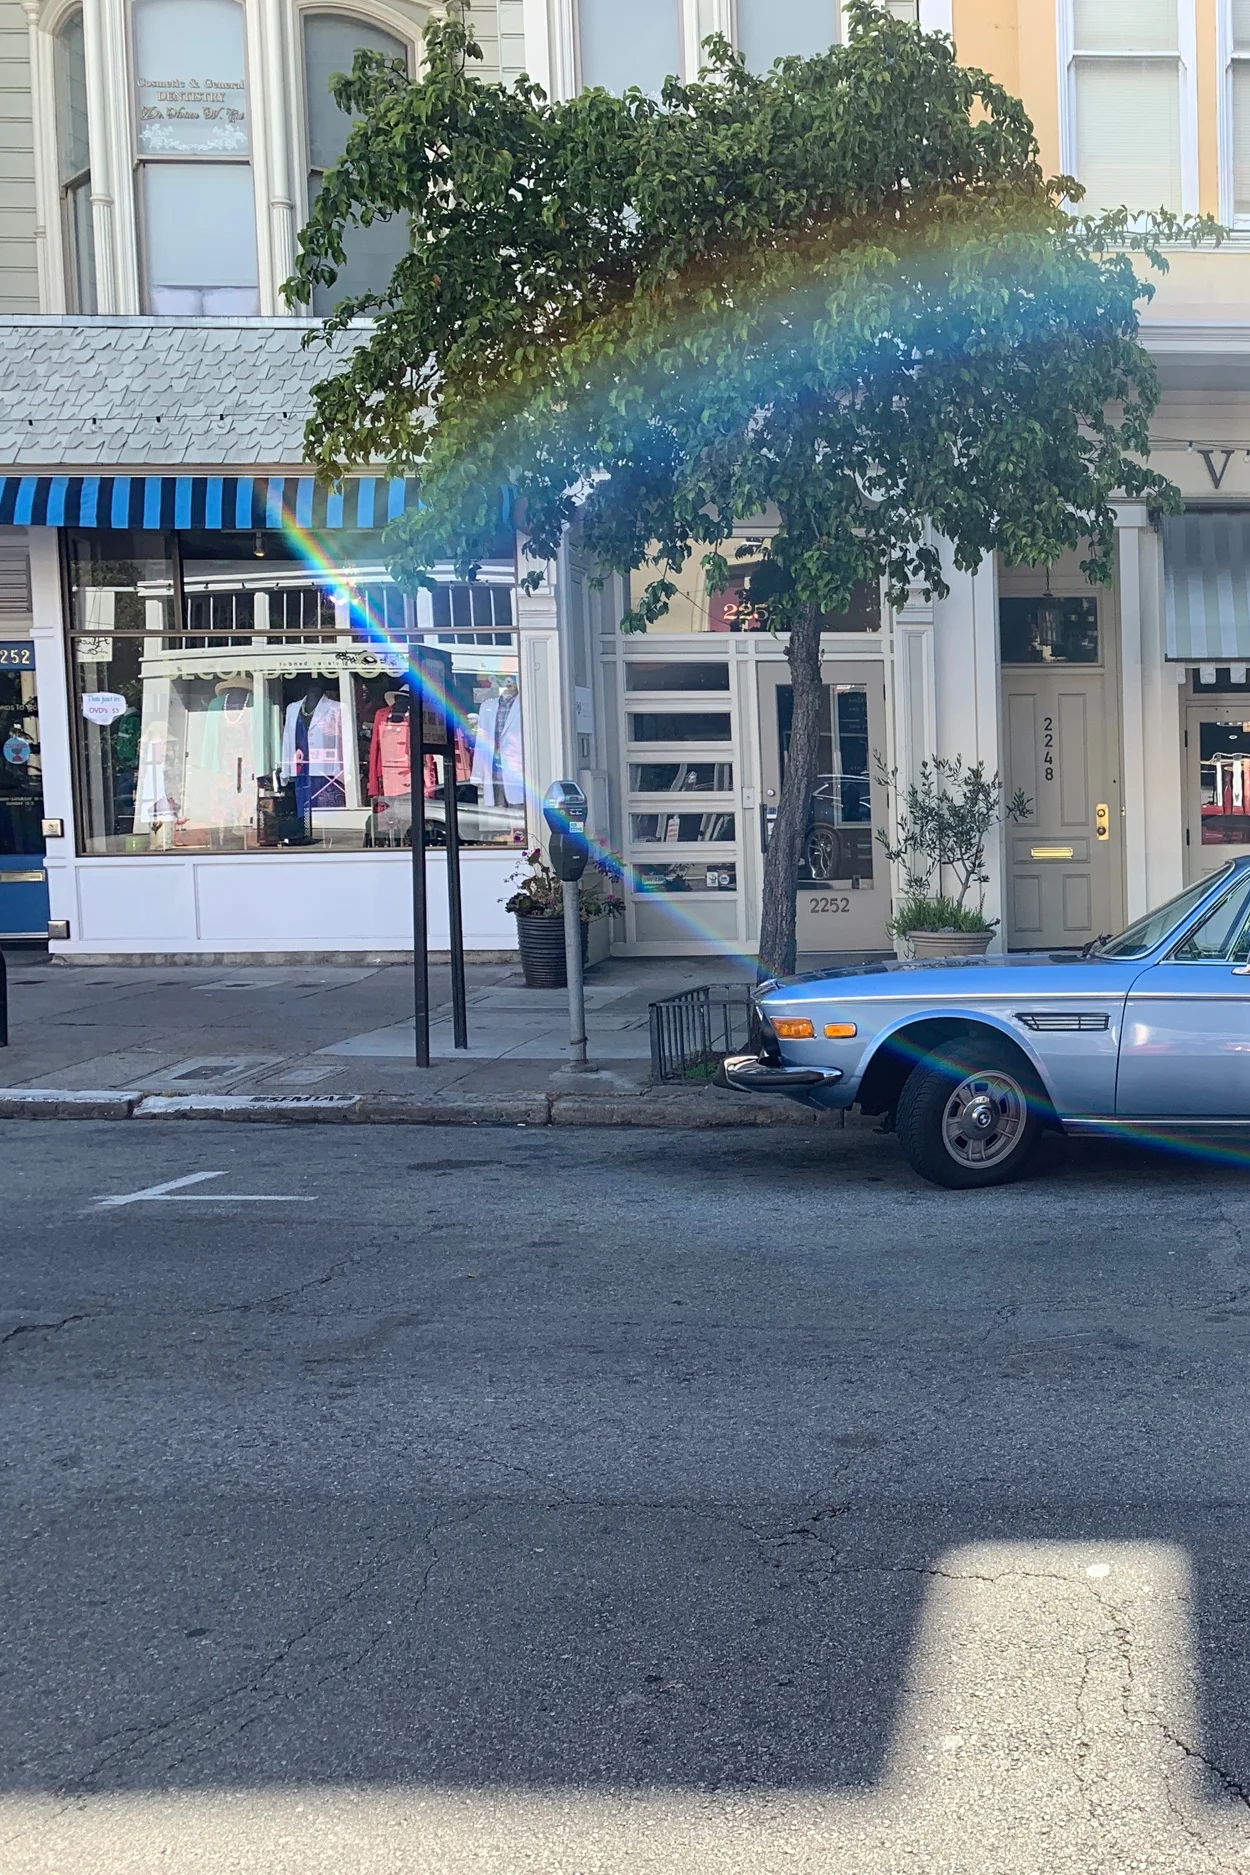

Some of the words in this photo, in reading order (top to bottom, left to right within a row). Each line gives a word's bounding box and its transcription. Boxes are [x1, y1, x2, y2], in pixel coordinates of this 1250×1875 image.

[137, 78, 185, 88] Cosmetic
[189, 79, 200, 88] &
[204, 79, 245, 89] General
[157, 91, 226, 102] DENTISTRY
[1043, 717, 1054, 781] 2248
[809, 897, 850, 914] 2252
